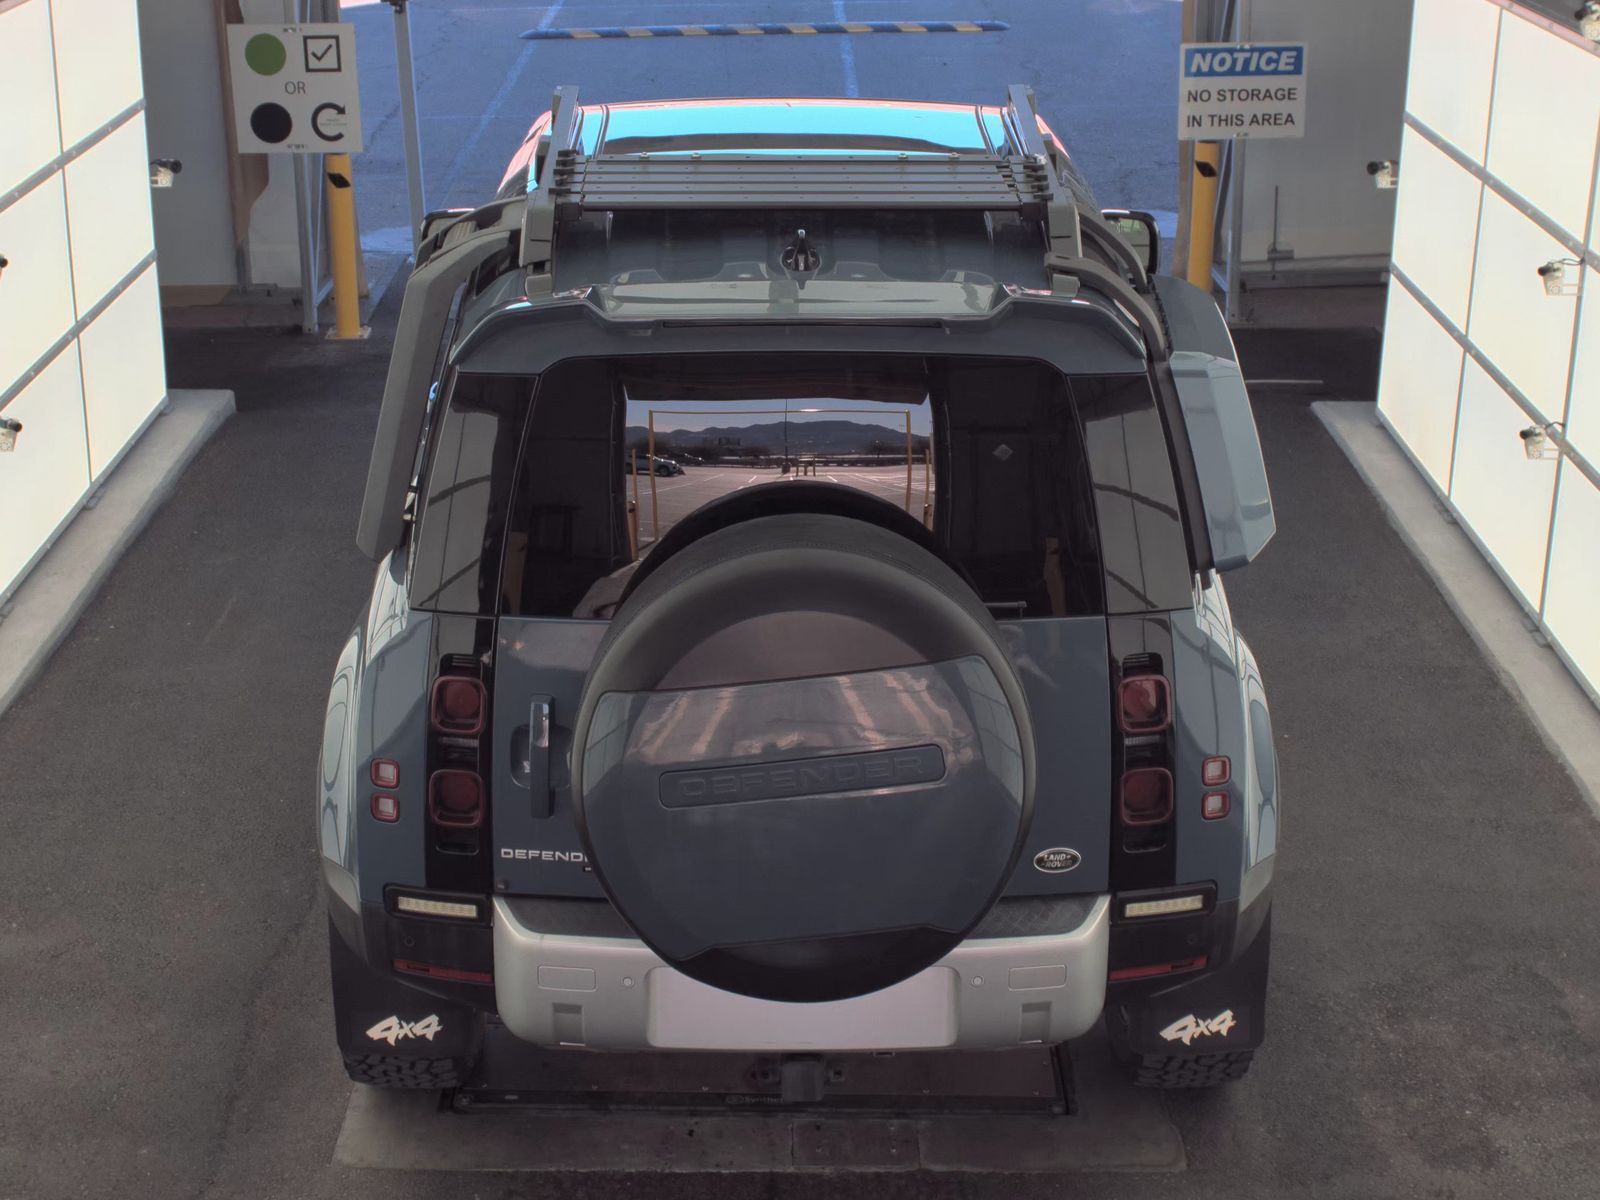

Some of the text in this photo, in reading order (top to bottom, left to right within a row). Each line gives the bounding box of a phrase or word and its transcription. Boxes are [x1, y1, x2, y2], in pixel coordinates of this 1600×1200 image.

[1191, 51, 1297, 73] NOTICE
[284, 81, 306, 95] OR
[1187, 87, 1298, 103] NO STORAGE
[1186, 113, 1296, 128] IN THIS AREA
[680, 757, 923, 795] DEFENDER
[1044, 852, 1066, 861] LAND
